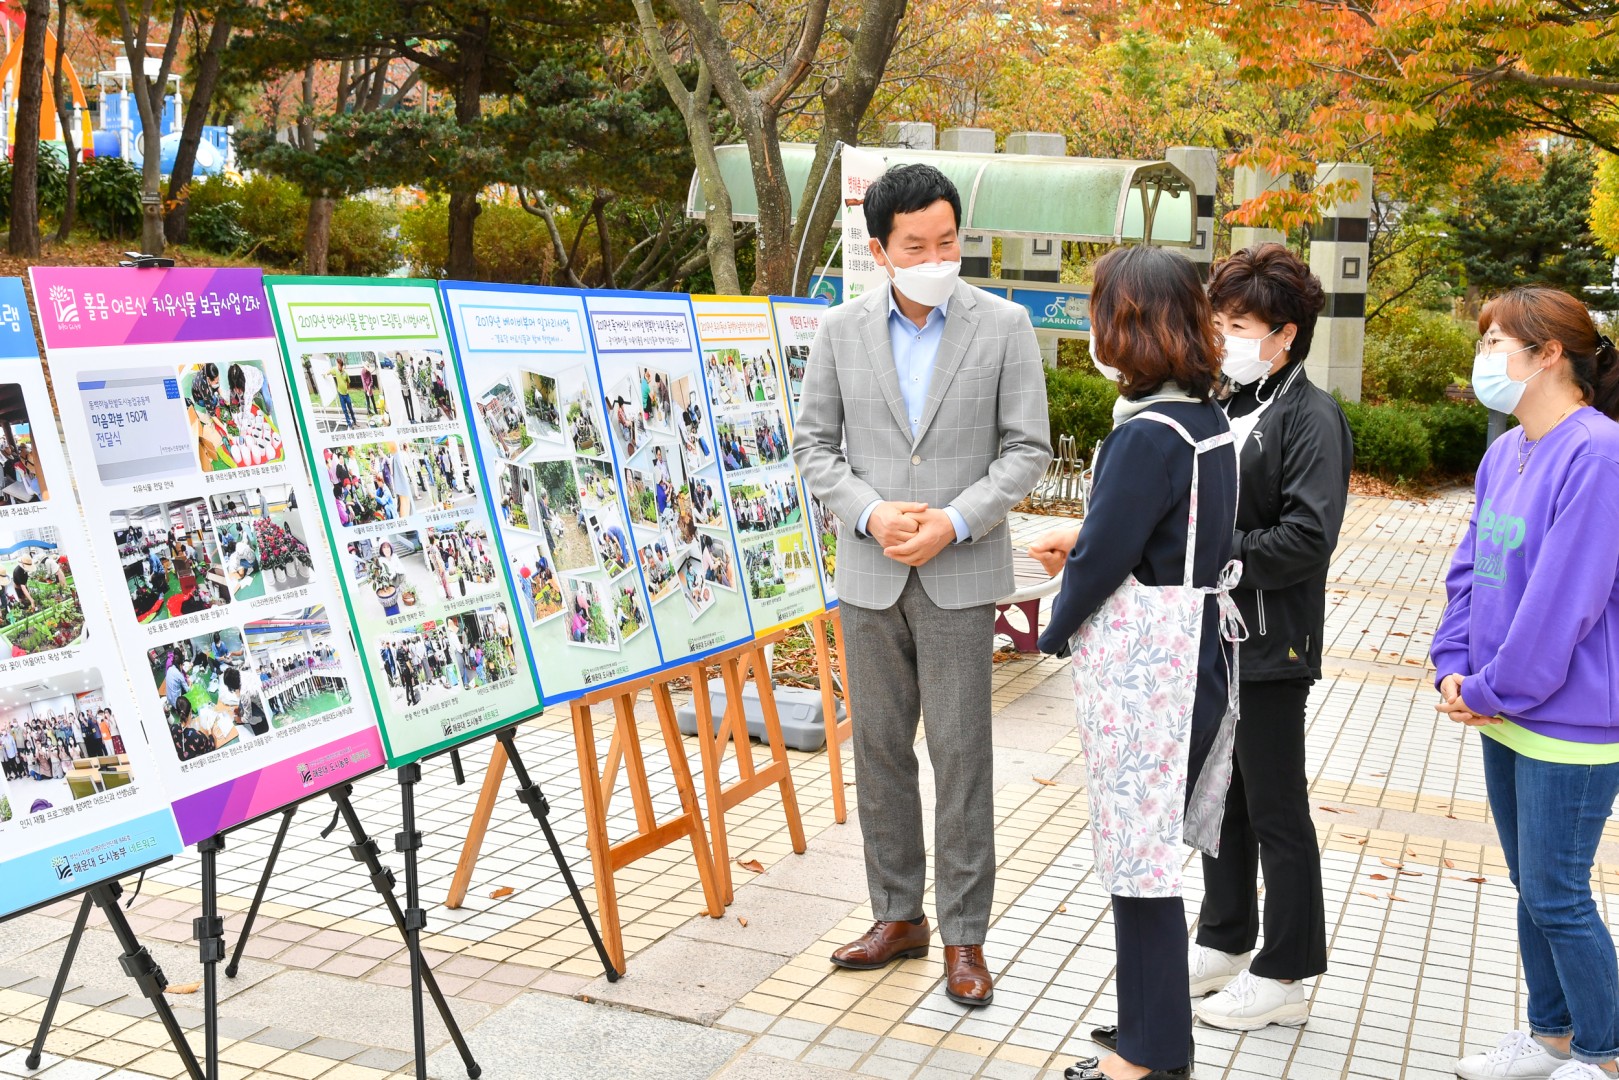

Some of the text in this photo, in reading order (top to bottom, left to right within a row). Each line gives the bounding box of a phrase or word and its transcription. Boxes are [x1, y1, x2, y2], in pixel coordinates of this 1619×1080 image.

[83, 291, 260, 321] 홀몸 어르신 치유식물 보급사업 2차
[298, 313, 430, 331] 2019년 반려식물 분갈이 드림팀 시범사업
[475, 315, 570, 332] 2019년 베이비부머 일자리사업
[1042, 316, 1082, 325] PARKING
[91, 409, 148, 429] 마음화분 150개
[96, 431, 121, 448] 전달식
[133, 483, 152, 493] 치유식물
[164, 480, 174, 489] 안내
[211, 610, 224, 620] 만들기
[9, 659, 21, 671] 꽃이
[47, 653, 59, 661] 옥상
[329, 757, 349, 772] 도시농부
[20, 817, 32, 829] 인지
[33, 814, 45, 824] 재활
[47, 805, 75, 820] 프로그램에
[76, 800, 92, 812] 참여한
[93, 792, 115, 805] 어르신과
[72, 836, 157, 873] 해운대 도시농부 네트워크
